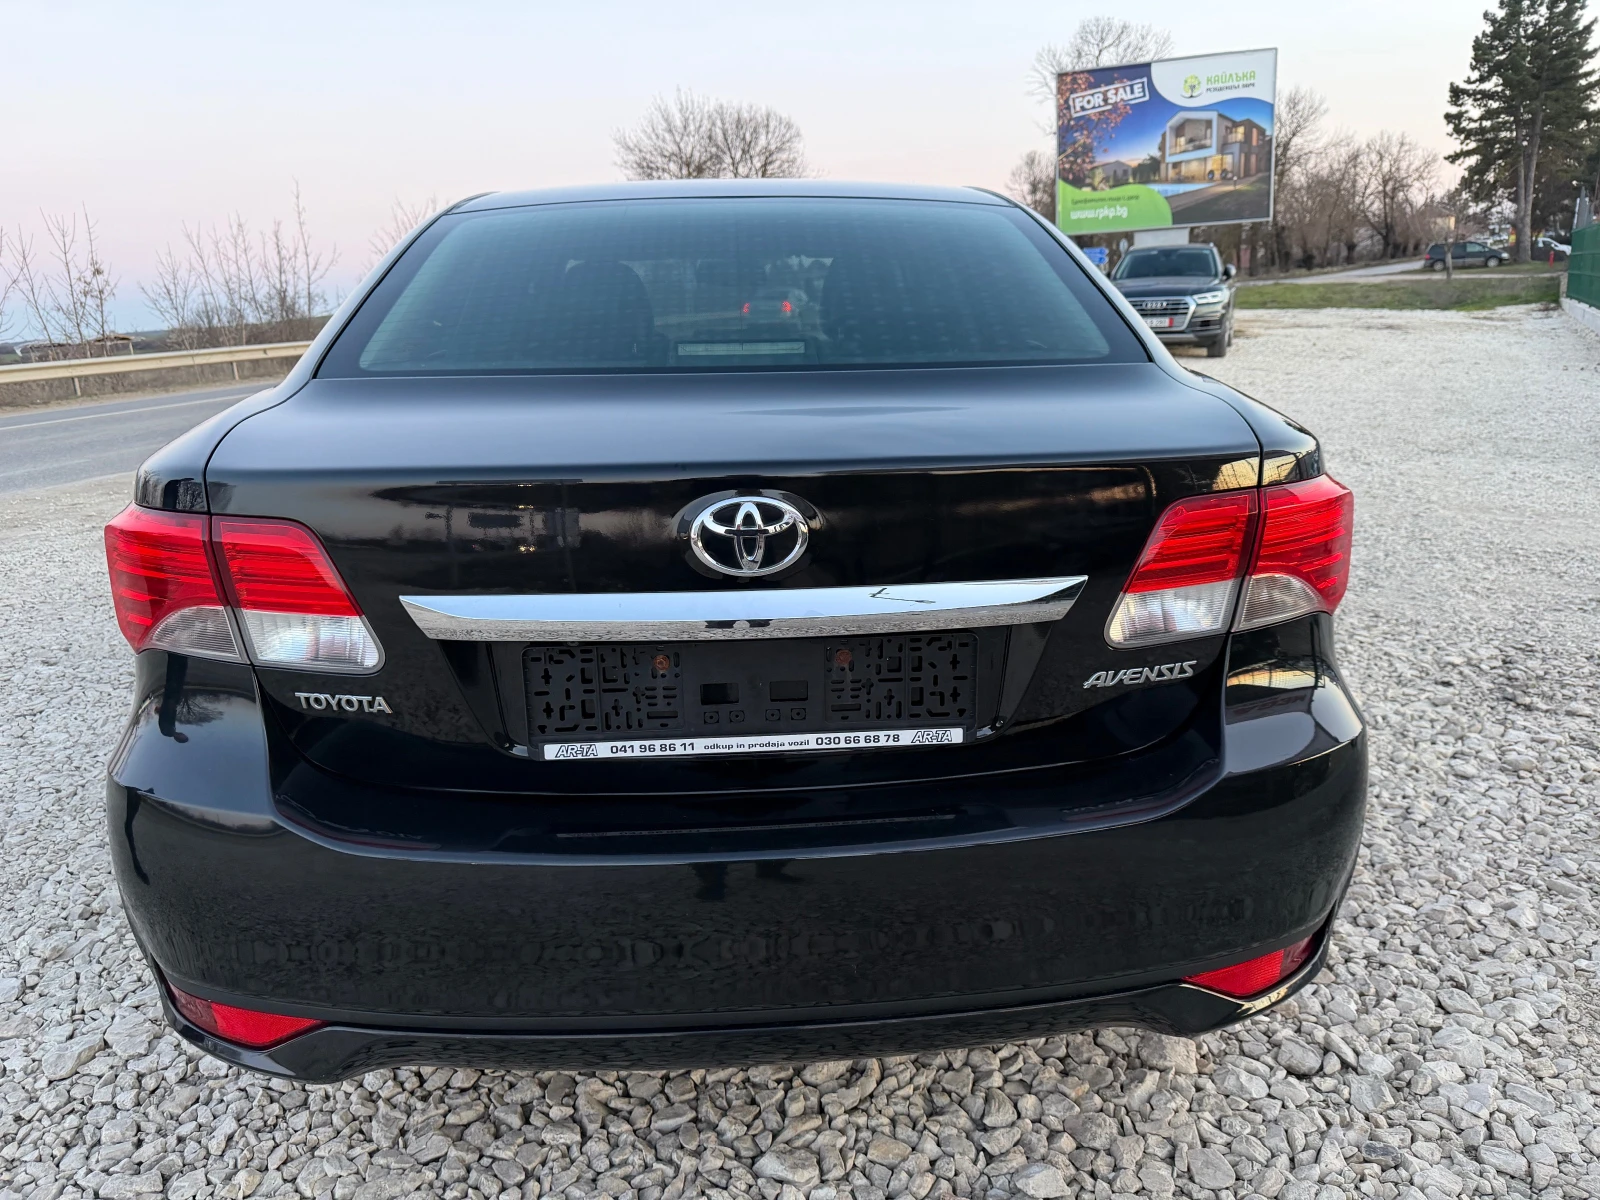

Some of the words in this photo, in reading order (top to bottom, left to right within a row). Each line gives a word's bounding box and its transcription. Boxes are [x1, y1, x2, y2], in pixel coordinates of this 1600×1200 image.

[1206, 70, 1256, 86] КАЙЛЪКА
[1074, 92, 1106, 111] FOR
[1107, 83, 1145, 104] SALE
[1070, 204, 1128, 220] www.rpkp.bg
[1082, 659, 1198, 690] AVENSIS
[294, 692, 392, 714] TOYOTA
[555, 743, 598, 758] AR-TA
[610, 744, 635, 755] 041
[639, 743, 656, 754] 96
[660, 742, 677, 753] 86
[680, 742, 695, 752] 11
[703, 742, 734, 751] odkup
[736, 741, 746, 749] in
[748, 741, 786, 751] prodaja
[815, 736, 841, 746] 030
[844, 735, 861, 745] 66
[864, 735, 880, 744] 68
[884, 734, 900, 743] 78
[911, 729, 953, 744] AR-TA
